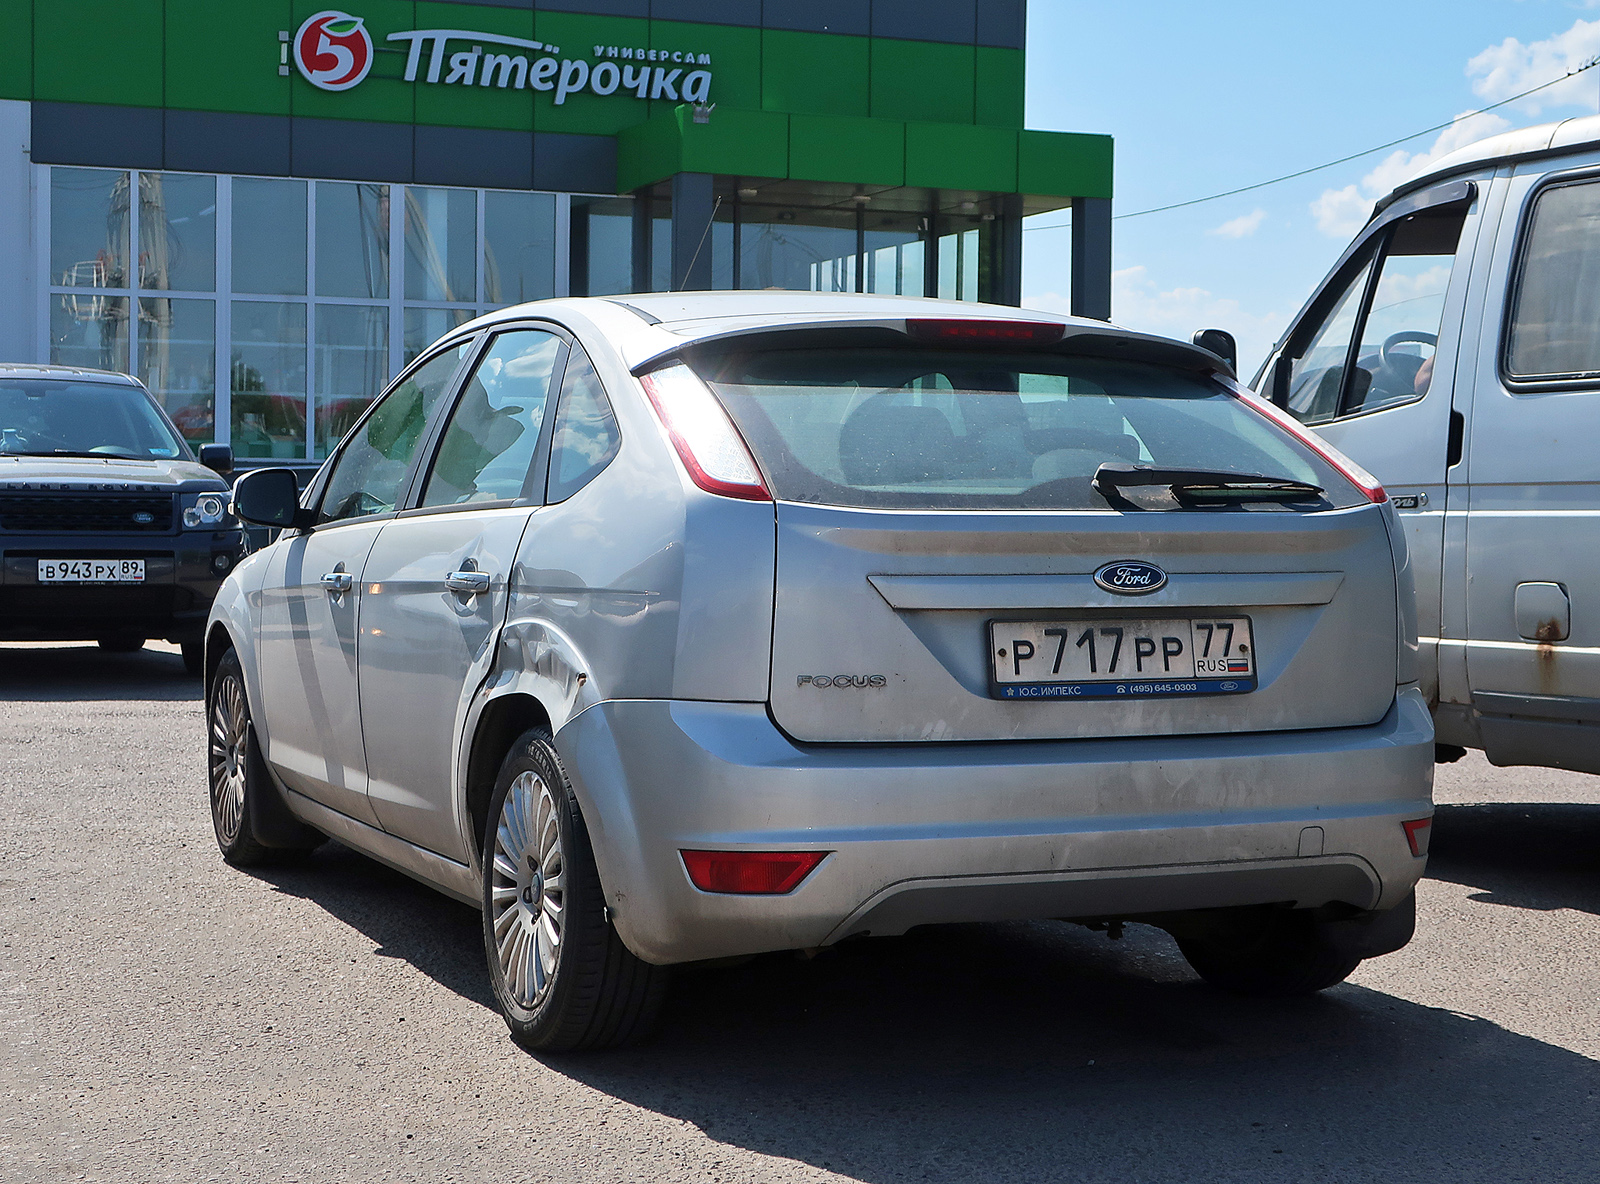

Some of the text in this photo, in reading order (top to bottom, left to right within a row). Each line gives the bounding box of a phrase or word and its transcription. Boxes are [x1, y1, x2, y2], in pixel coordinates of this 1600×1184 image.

[593, 45, 711, 65] УНИВЕРСАМ
[386, 29, 712, 106] Пятёрочка
[121, 561, 139, 574] 89
[1113, 567, 1151, 585] Ford
[1197, 623, 1234, 657] 77
[1197, 660, 1227, 672] RUS
[797, 674, 887, 688] FOCUS
[1130, 683, 1197, 693] (495) 645-0303
